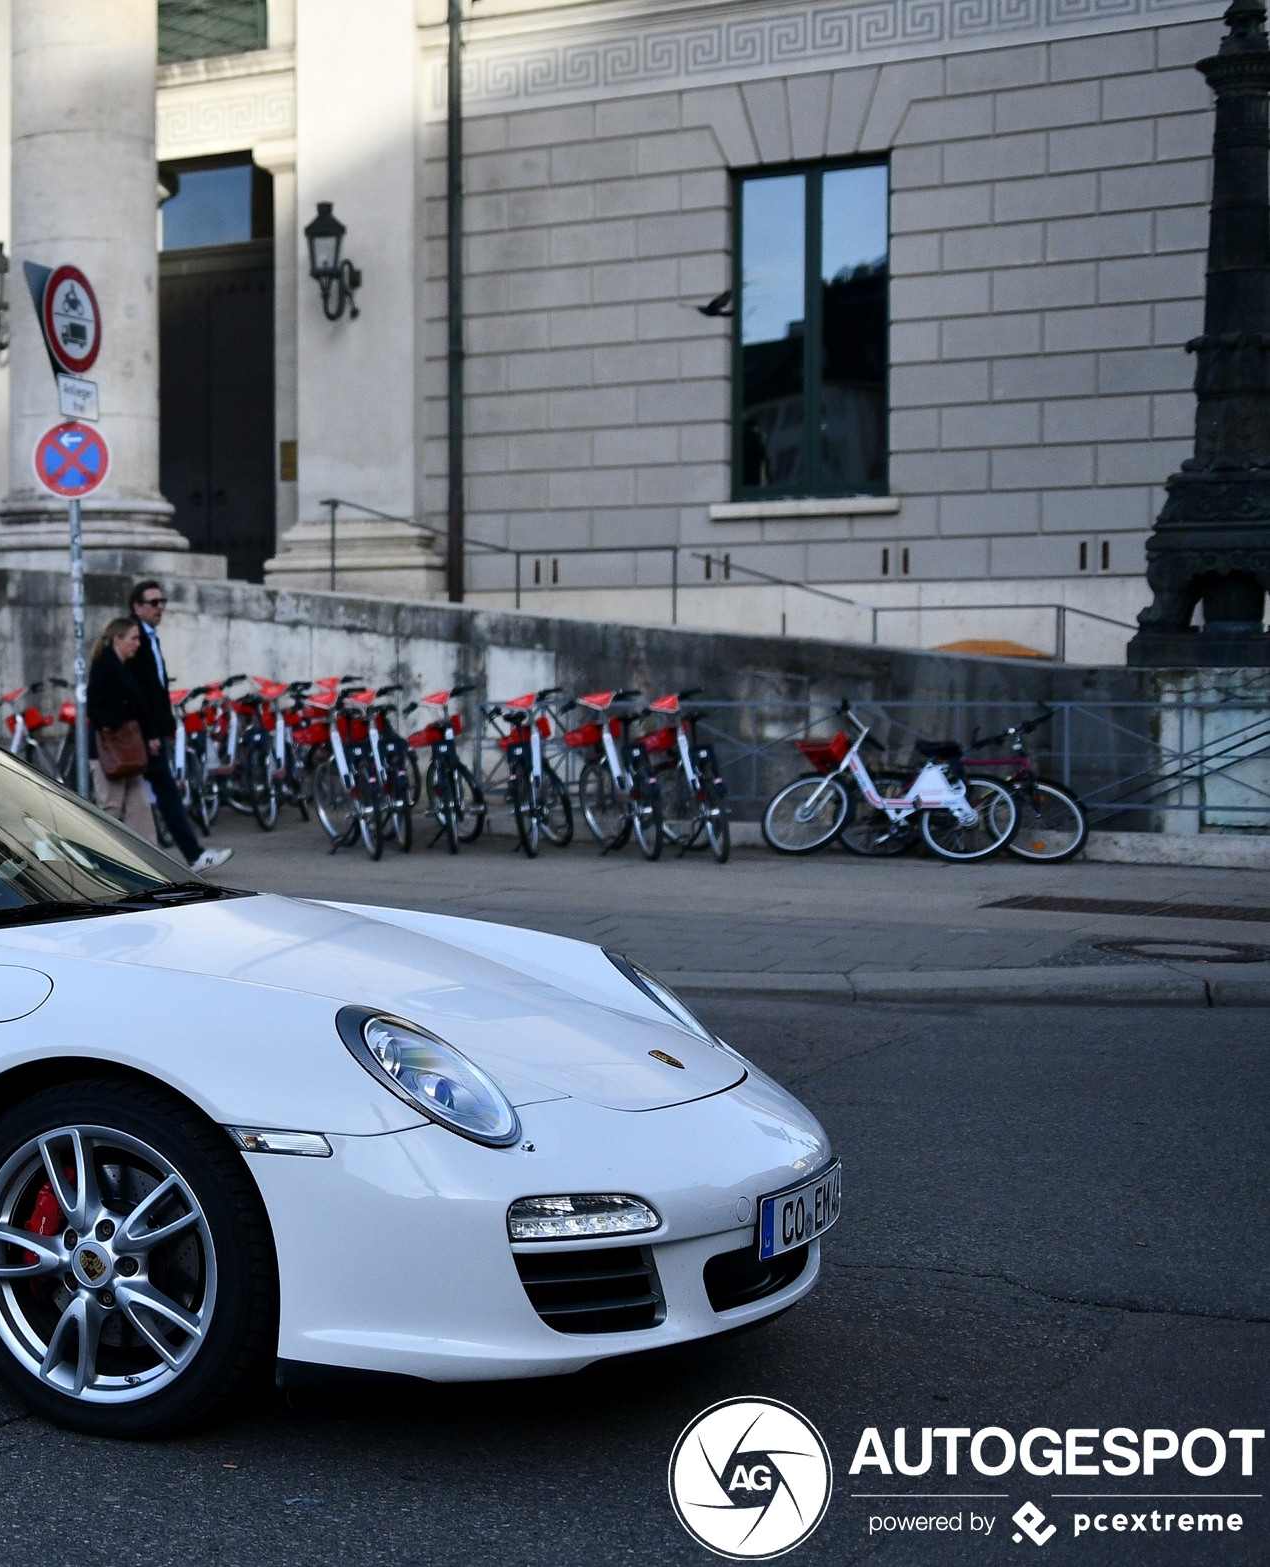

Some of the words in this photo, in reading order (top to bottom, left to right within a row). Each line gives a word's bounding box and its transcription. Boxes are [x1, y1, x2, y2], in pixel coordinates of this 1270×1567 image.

[205, 857, 214, 865] N
[782, 1196, 805, 1245] CO
[815, 1180, 830, 1231] EM
